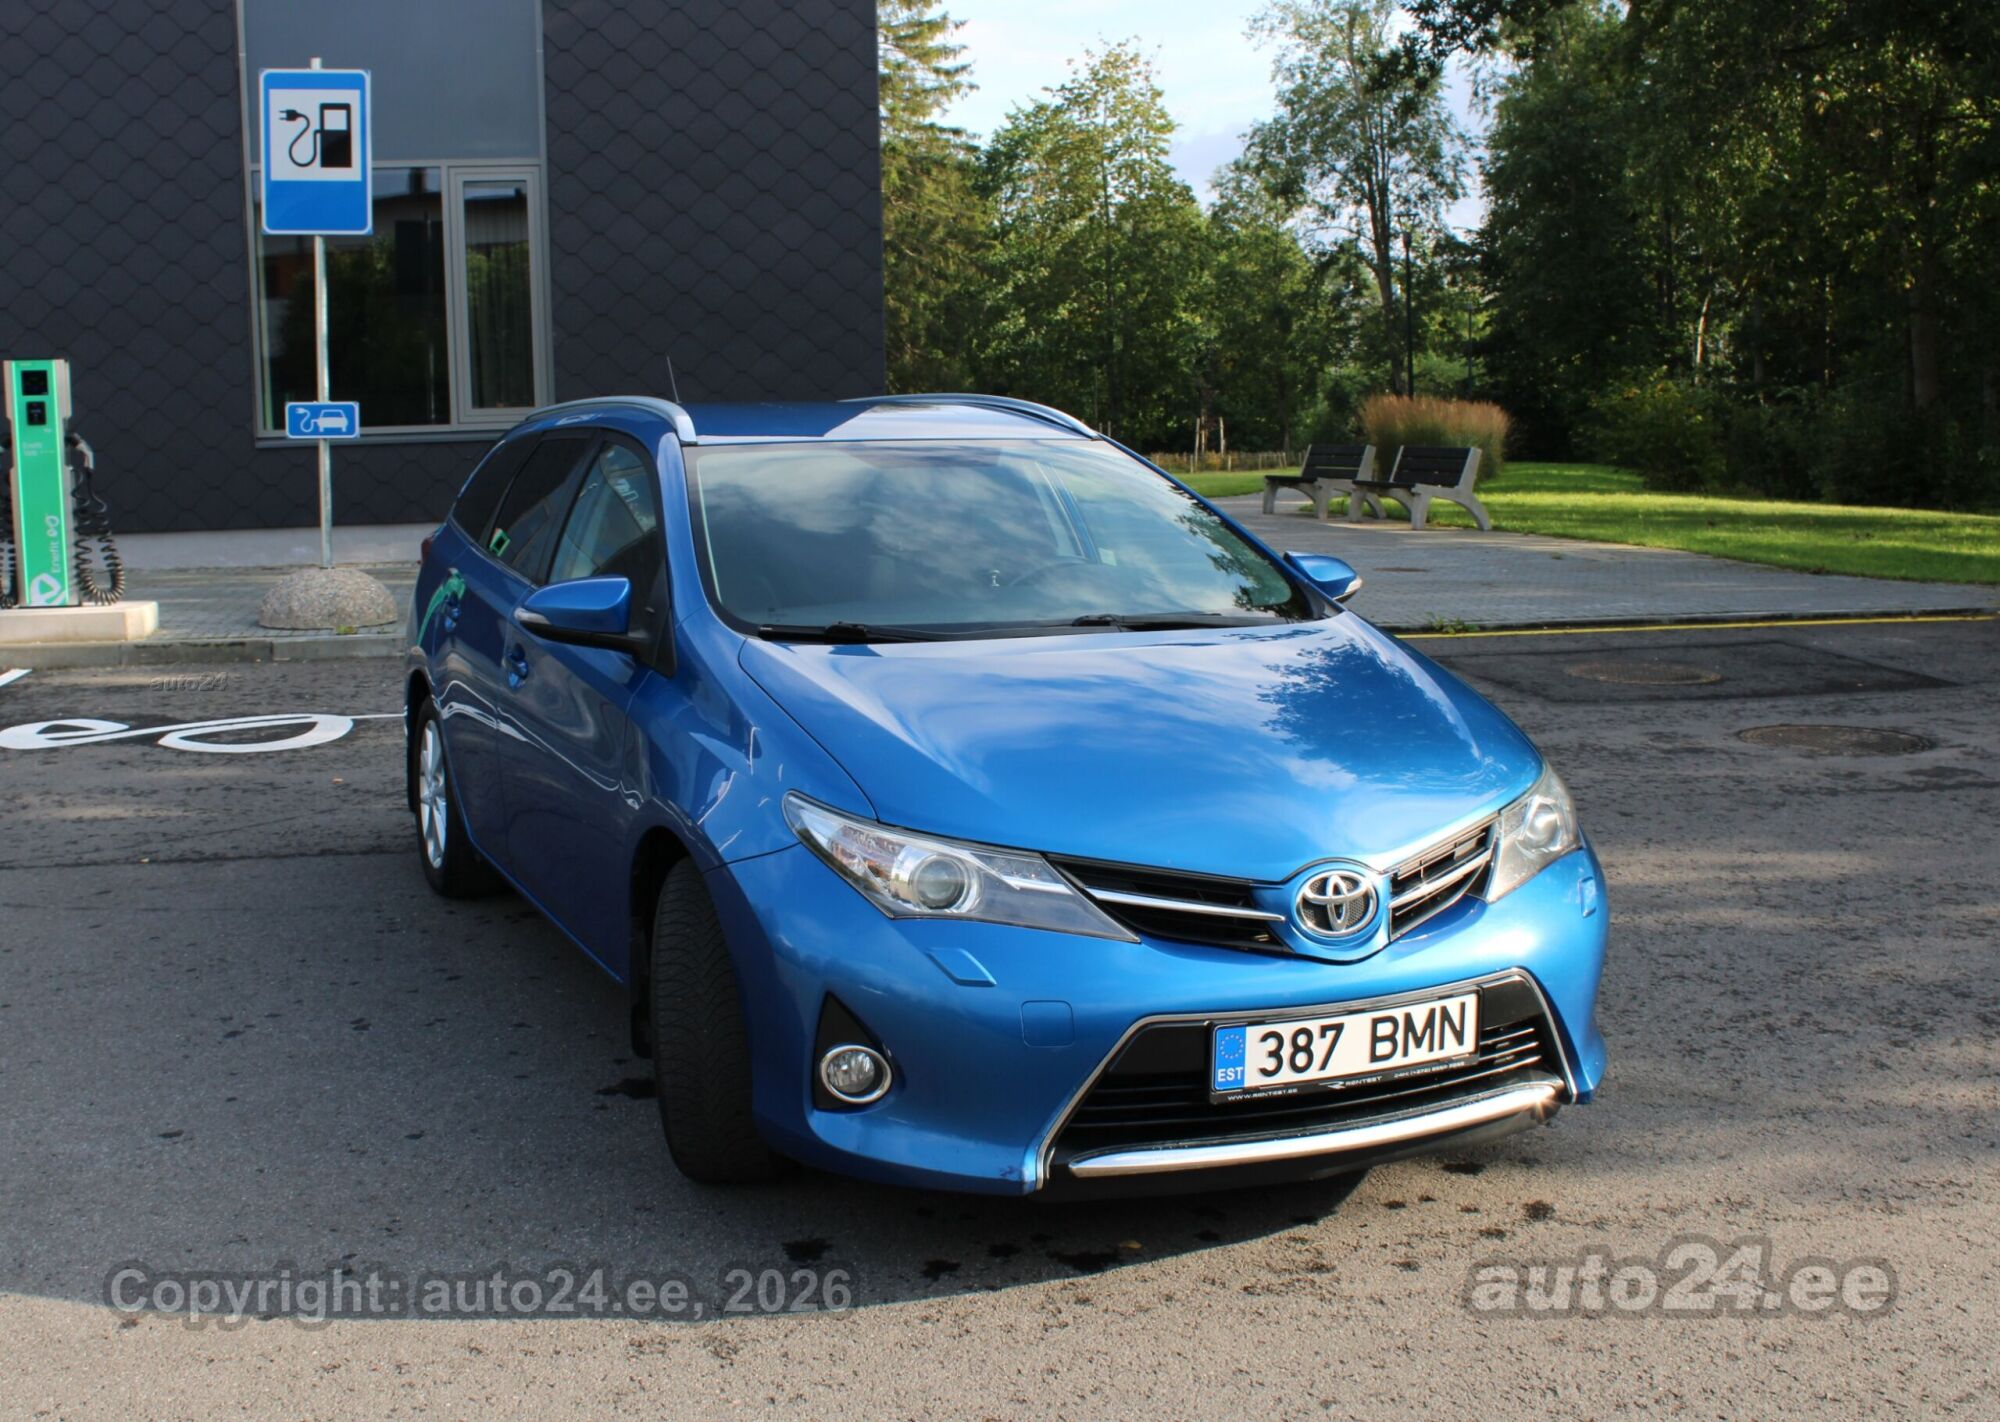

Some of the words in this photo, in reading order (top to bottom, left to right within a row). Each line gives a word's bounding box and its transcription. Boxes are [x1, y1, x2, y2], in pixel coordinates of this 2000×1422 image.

[1258, 1022, 1345, 1077] 387
[1370, 1001, 1466, 1063] BMN
[1217, 1065, 1243, 1082] EST
